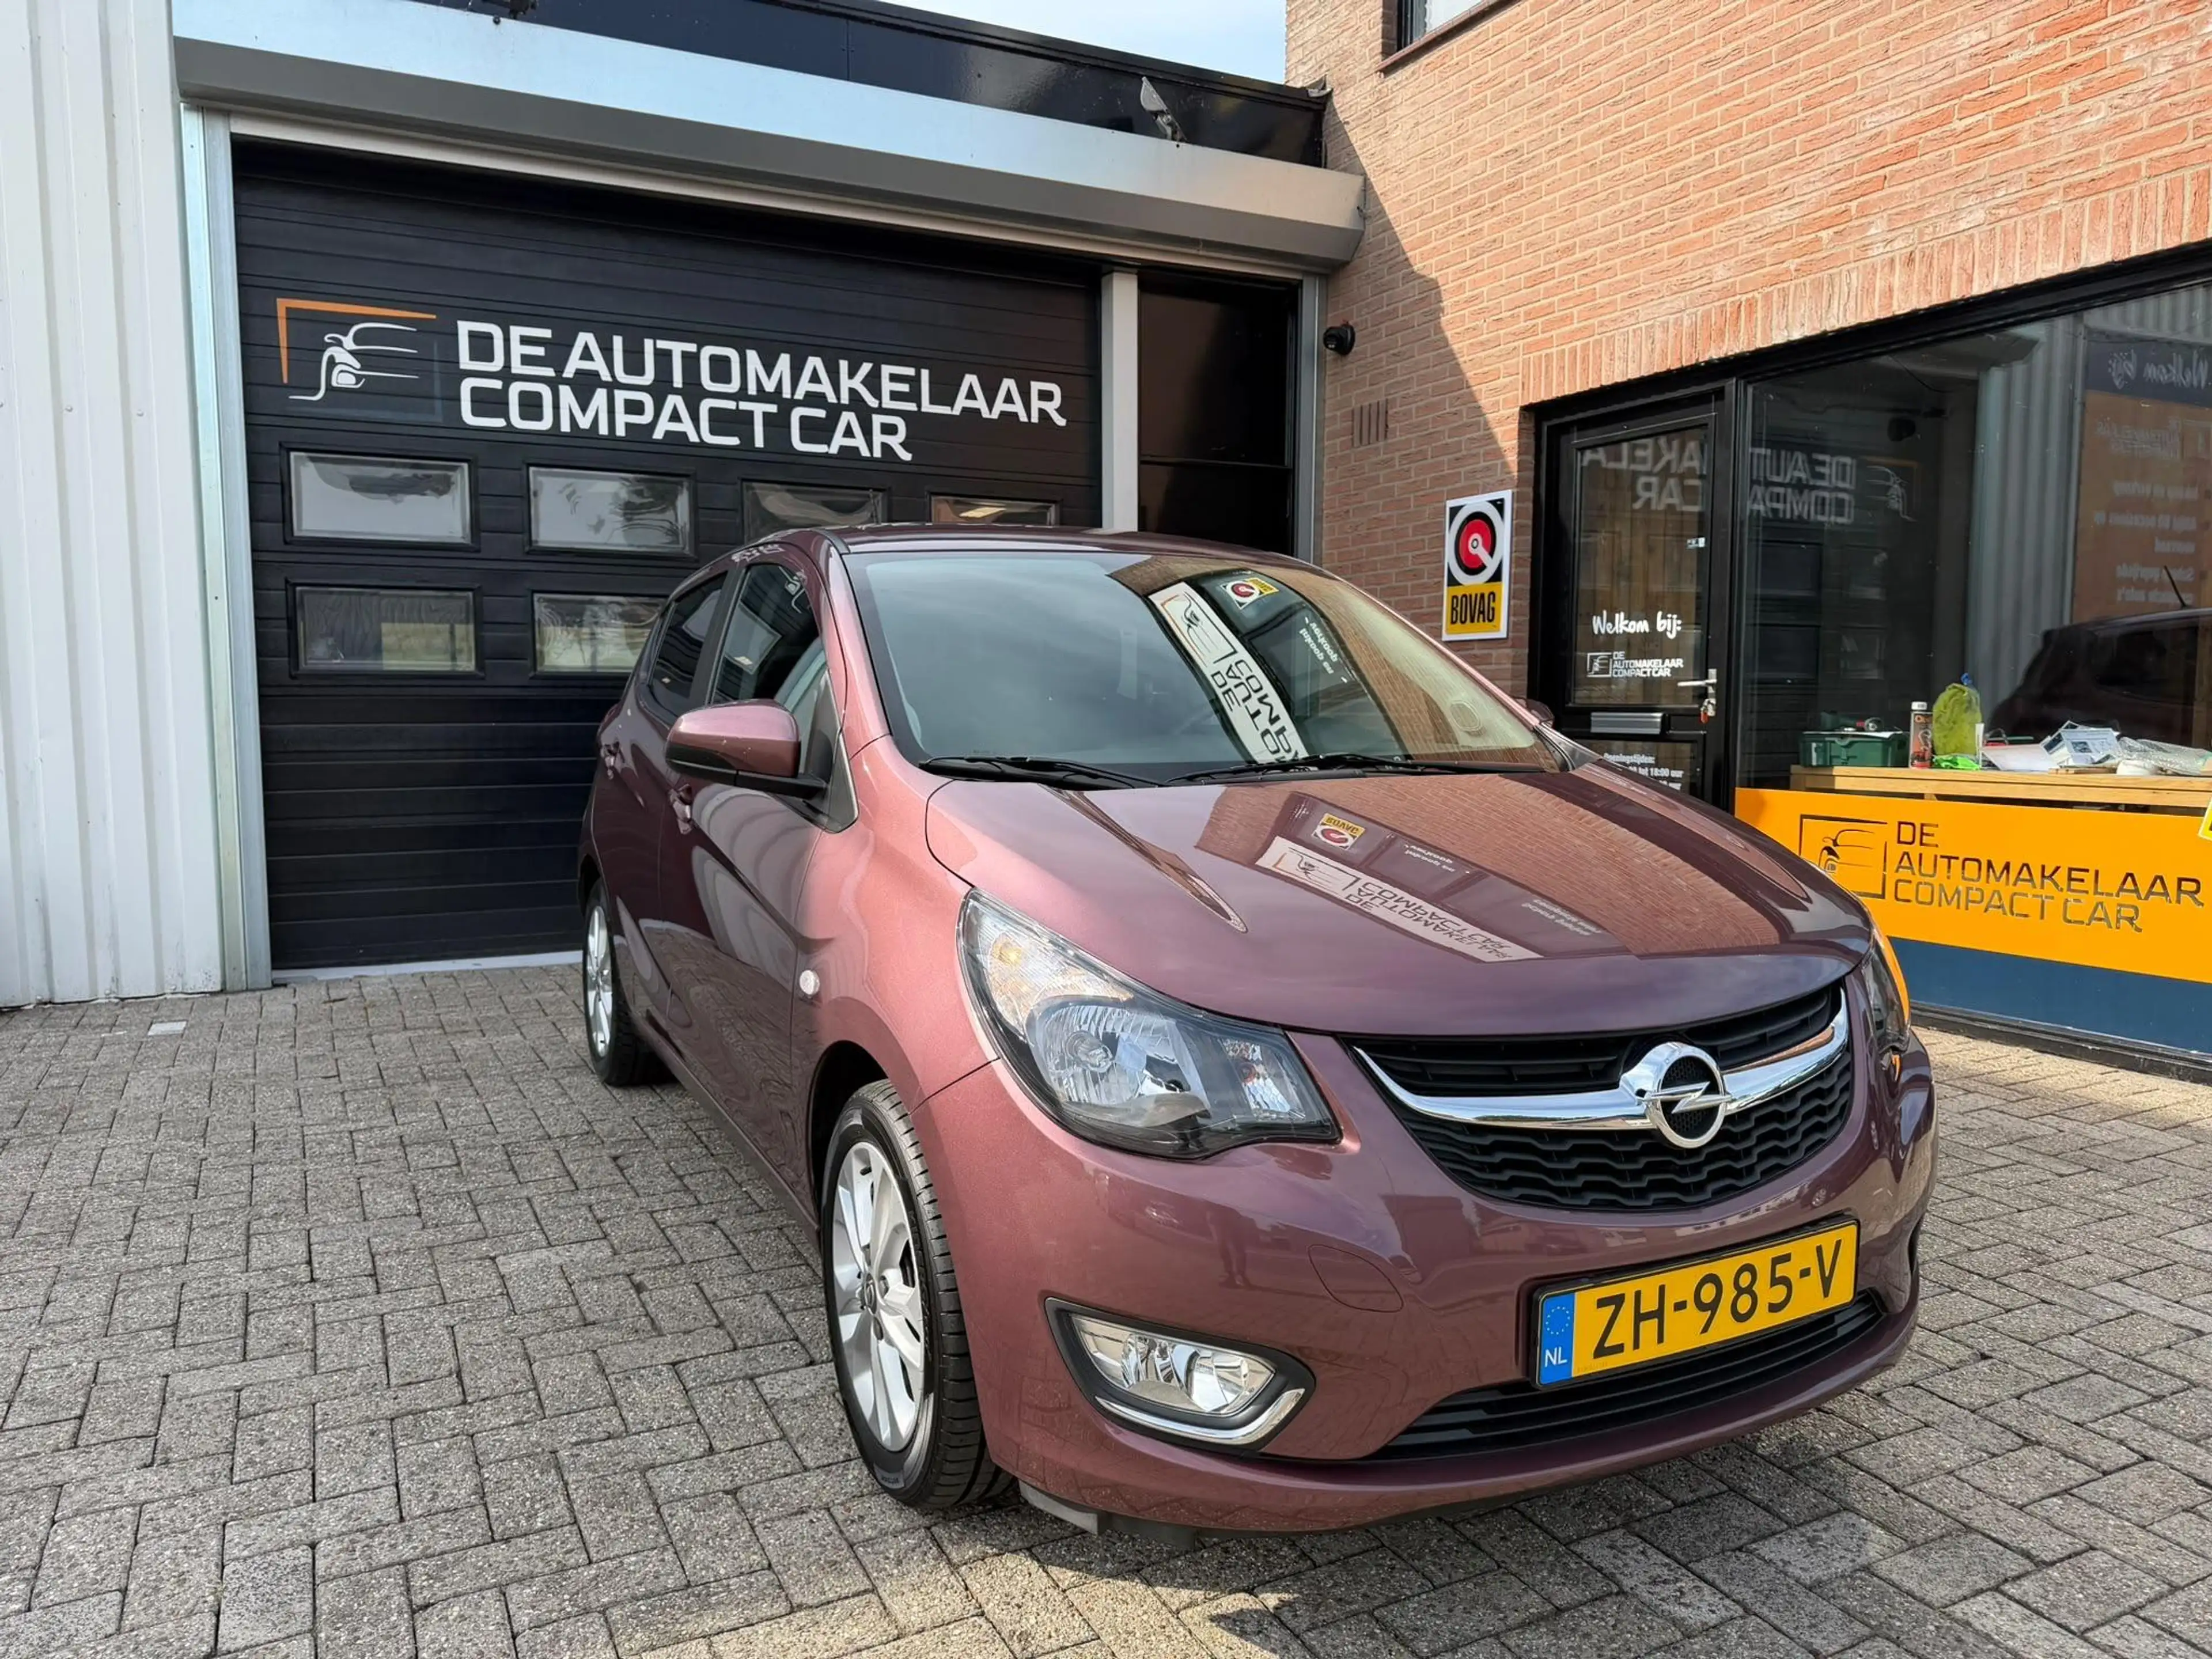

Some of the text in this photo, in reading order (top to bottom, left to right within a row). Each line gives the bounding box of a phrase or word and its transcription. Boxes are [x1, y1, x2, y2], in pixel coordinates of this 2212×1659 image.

[457, 321, 1066, 426] DE AUTOMAKELAAR
[461, 377, 912, 460] COMPACT CAR
[1451, 592, 1495, 624] BOVAG
[1593, 610, 1682, 639] Welkom bij:
[1613, 652, 1625, 660] DE
[1613, 658, 1684, 668] AUTOMAKELAAR
[1612, 668, 1671, 677] COMPACT CAR
[1897, 821, 1940, 849] DE
[1895, 852, 2203, 907] AUTOMAKELAAR
[1894, 879, 2143, 933] COMPACT CAR
[1593, 1240, 1841, 1359] ZH-985-V
[1545, 1347, 1567, 1367] NL
